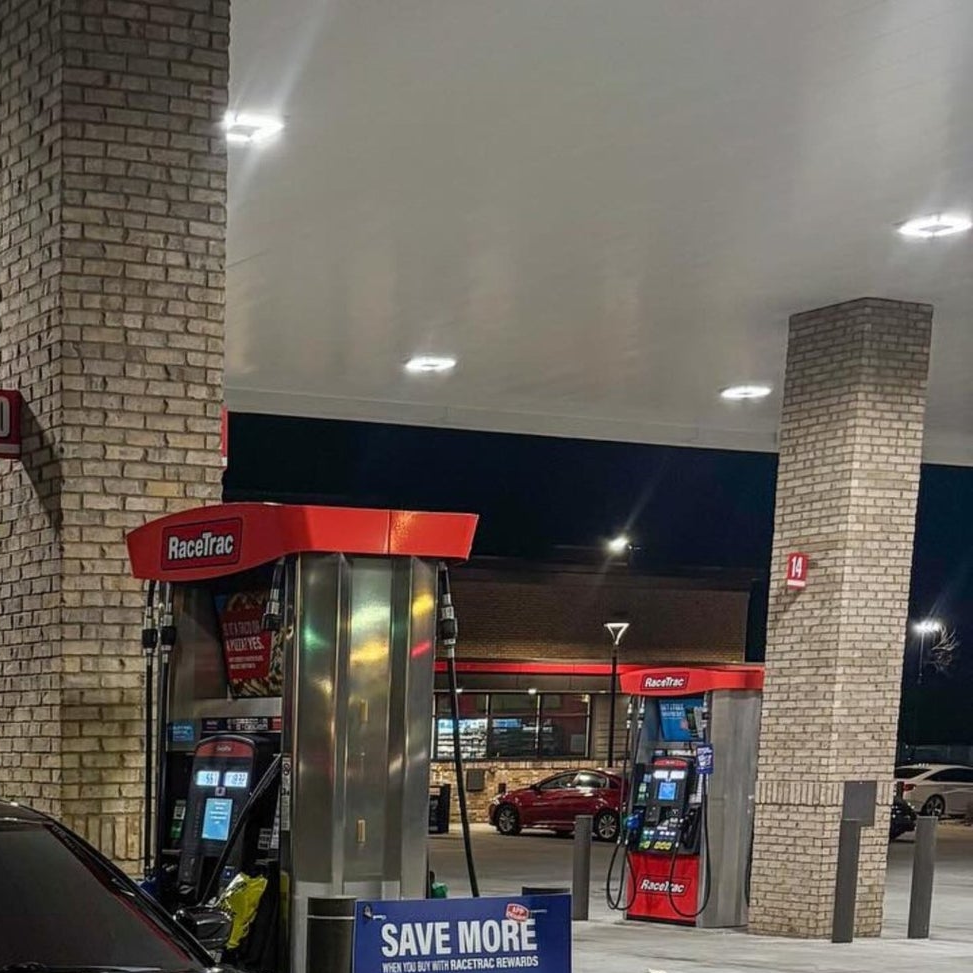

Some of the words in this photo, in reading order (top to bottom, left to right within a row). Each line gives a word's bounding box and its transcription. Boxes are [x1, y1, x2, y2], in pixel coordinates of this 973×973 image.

[167, 531, 234, 560] RaceTrac
[791, 555, 804, 578] 14
[644, 676, 685, 688] RaceTrac
[640, 879, 685, 893] RaceTac
[381, 921, 452, 958] SAVE
[458, 918, 538, 954] MORE
[382, 962, 403, 973] WHEN
[403, 961, 417, 973] YOU
[417, 960, 431, 972] BUY
[431, 960, 450, 971] WITH
[450, 957, 495, 971] RACETRAC
[495, 955, 539, 968] REWARDS
